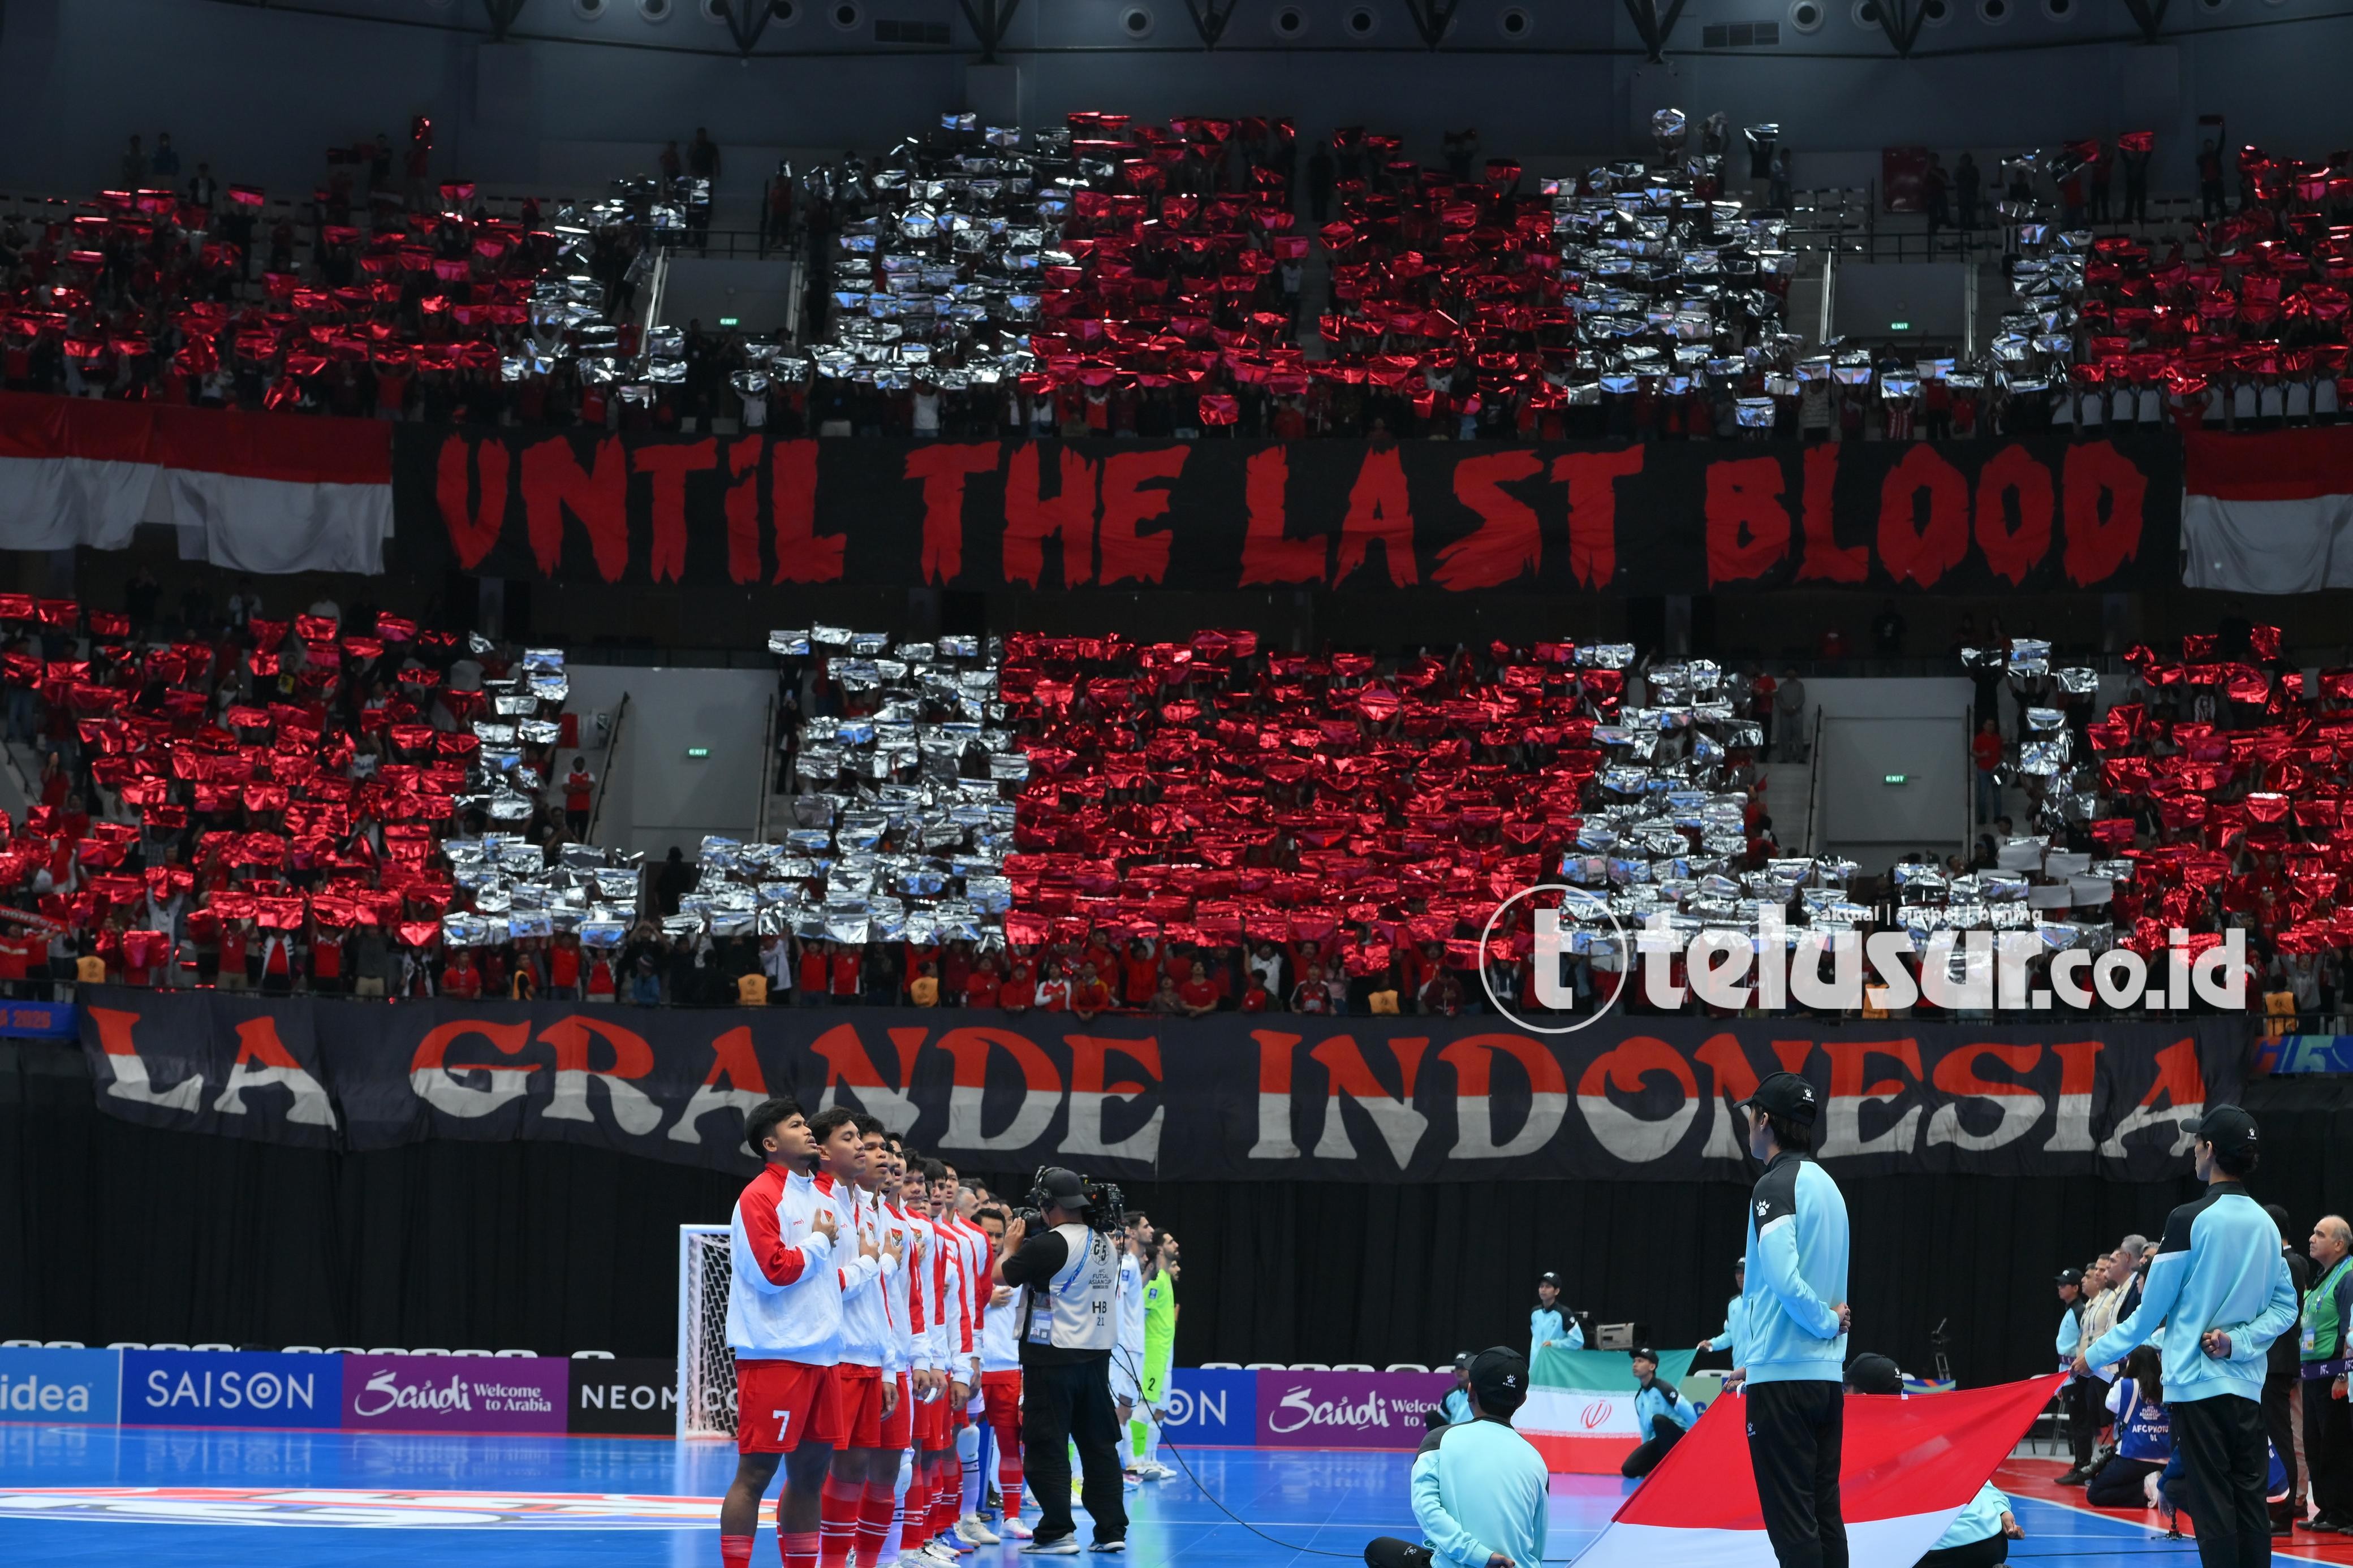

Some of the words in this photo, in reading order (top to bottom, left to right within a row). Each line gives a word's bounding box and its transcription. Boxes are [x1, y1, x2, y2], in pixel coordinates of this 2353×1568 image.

[905, 440, 1191, 590] THE
[1238, 444, 1645, 591] LAST
[1705, 442, 2148, 588] BLOOD
[87, 1005, 338, 1131] LA
[410, 1014, 1165, 1164] GRANDE
[1248, 1029, 2207, 1171] INDONESIA
[1092, 1301, 1107, 1314] HB
[1097, 1317, 1104, 1326] 21
[145, 1370, 314, 1409] SAISON
[473, 1383, 541, 1398] Welcome
[1148, 1377, 1155, 1391] 2
[0, 1374, 89, 1412] idea
[354, 1369, 472, 1416] Saudi
[485, 1399, 501, 1411] to
[503, 1398, 552, 1412] Arabia
[1269, 1385, 1390, 1433] Saudi
[1391, 1398, 1440, 1413] Welco
[773, 1410, 790, 1441] 7
[1404, 1415, 1420, 1427] to
[2132, 1424, 2148, 1433] AFC
